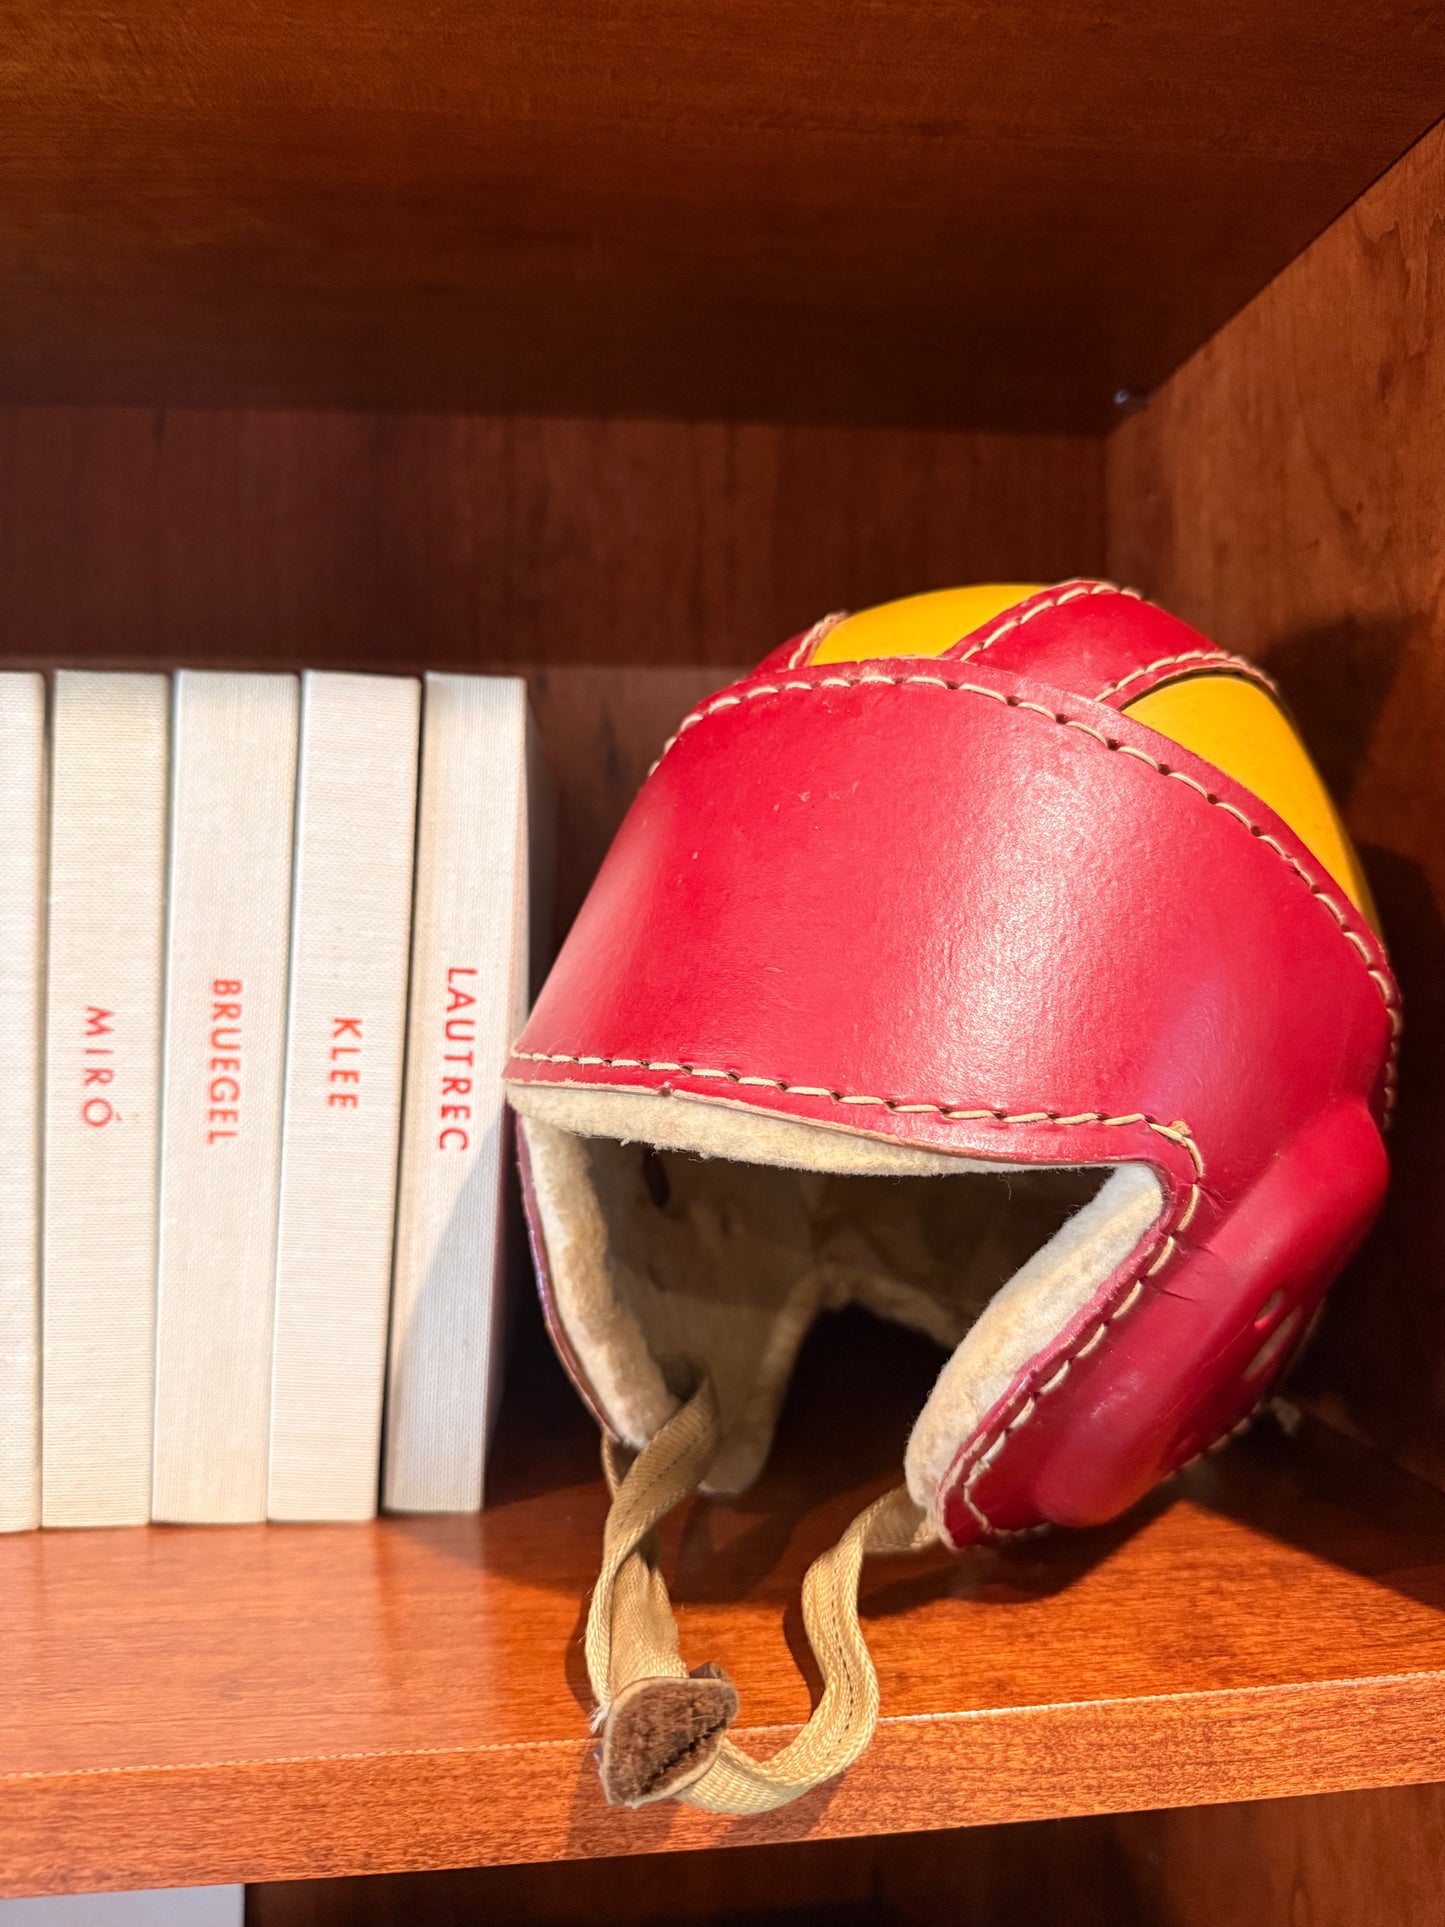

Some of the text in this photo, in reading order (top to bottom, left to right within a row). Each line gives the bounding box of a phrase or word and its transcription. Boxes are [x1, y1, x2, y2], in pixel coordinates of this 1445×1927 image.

[81, 1004, 123, 1129] MIRÓ
[205, 977, 244, 1146] BRUEGEL
[325, 1016, 364, 1110] KLEE
[437, 966, 479, 1153] LAUTREC
